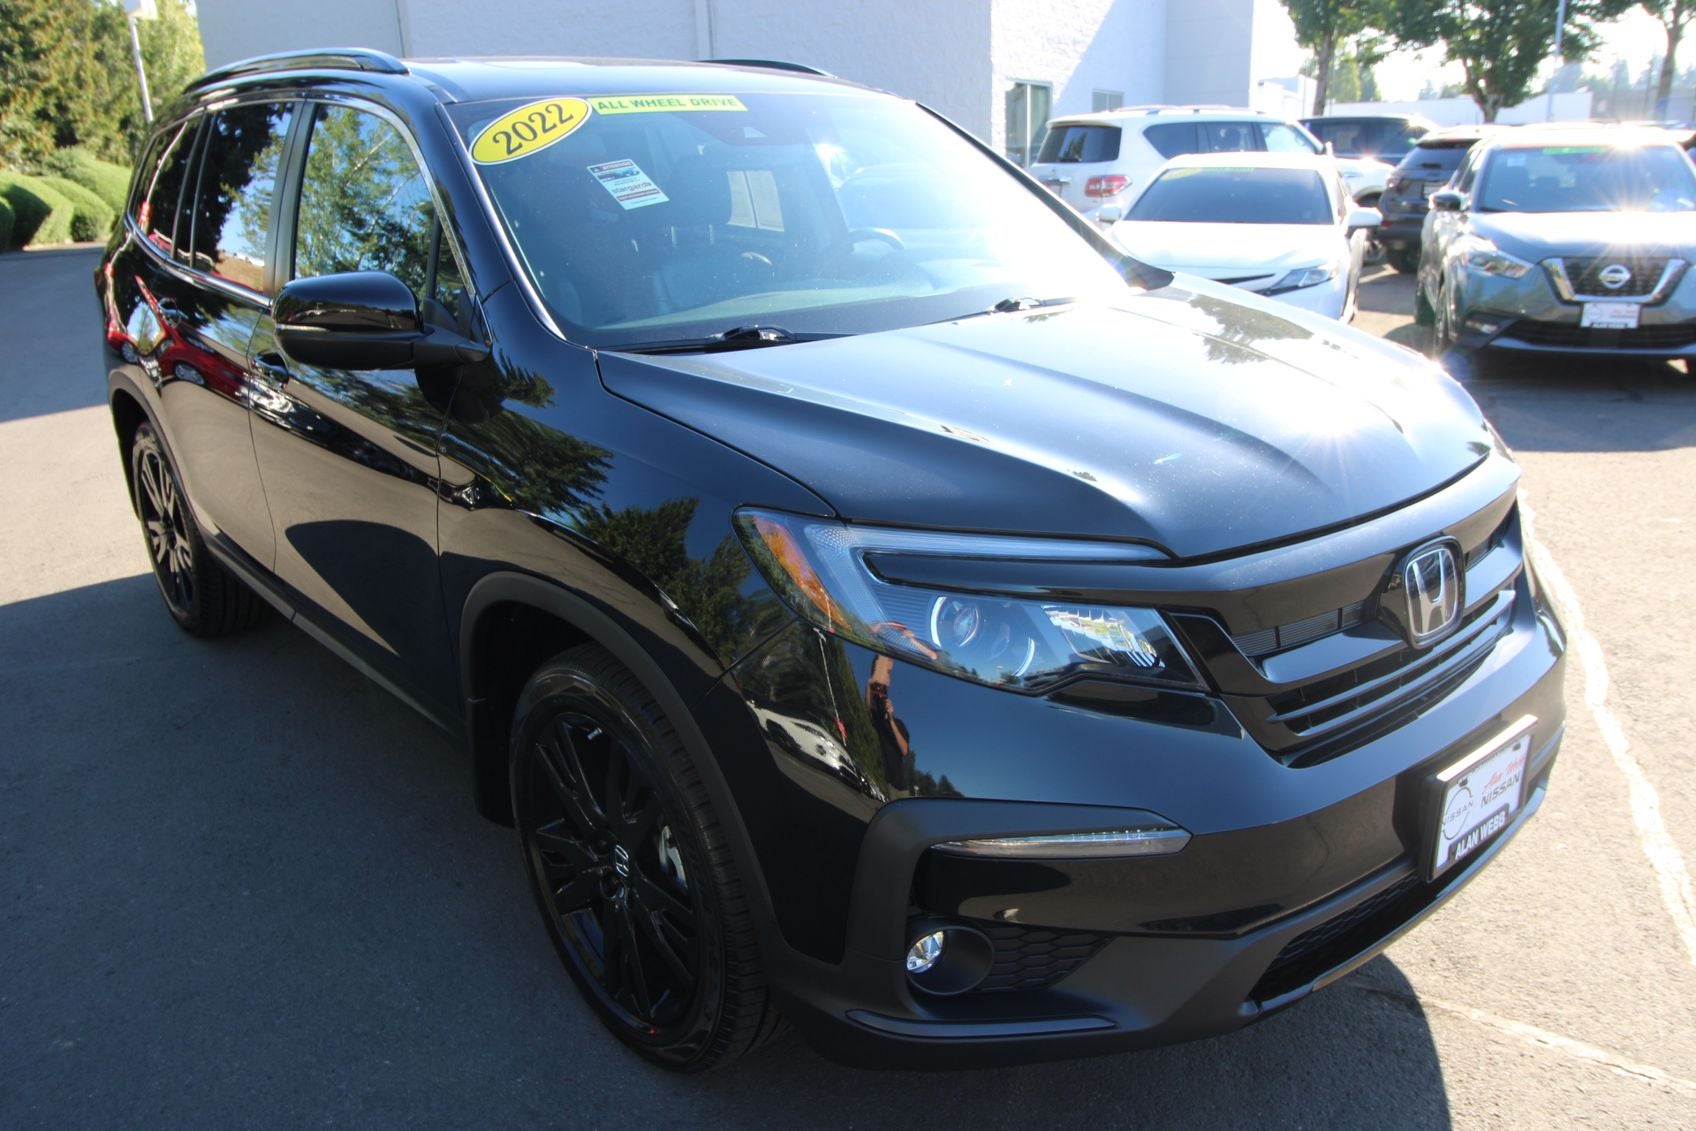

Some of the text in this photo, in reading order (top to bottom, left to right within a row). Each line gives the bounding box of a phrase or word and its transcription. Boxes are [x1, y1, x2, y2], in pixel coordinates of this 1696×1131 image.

[598, 98, 738, 110] ALL WHEEL DRIVE
[493, 104, 574, 155] 2022
[1481, 771, 1520, 808] NISSAN
[1442, 801, 1474, 827] NISSAN
[1455, 811, 1506, 860] ALAN WEBB
